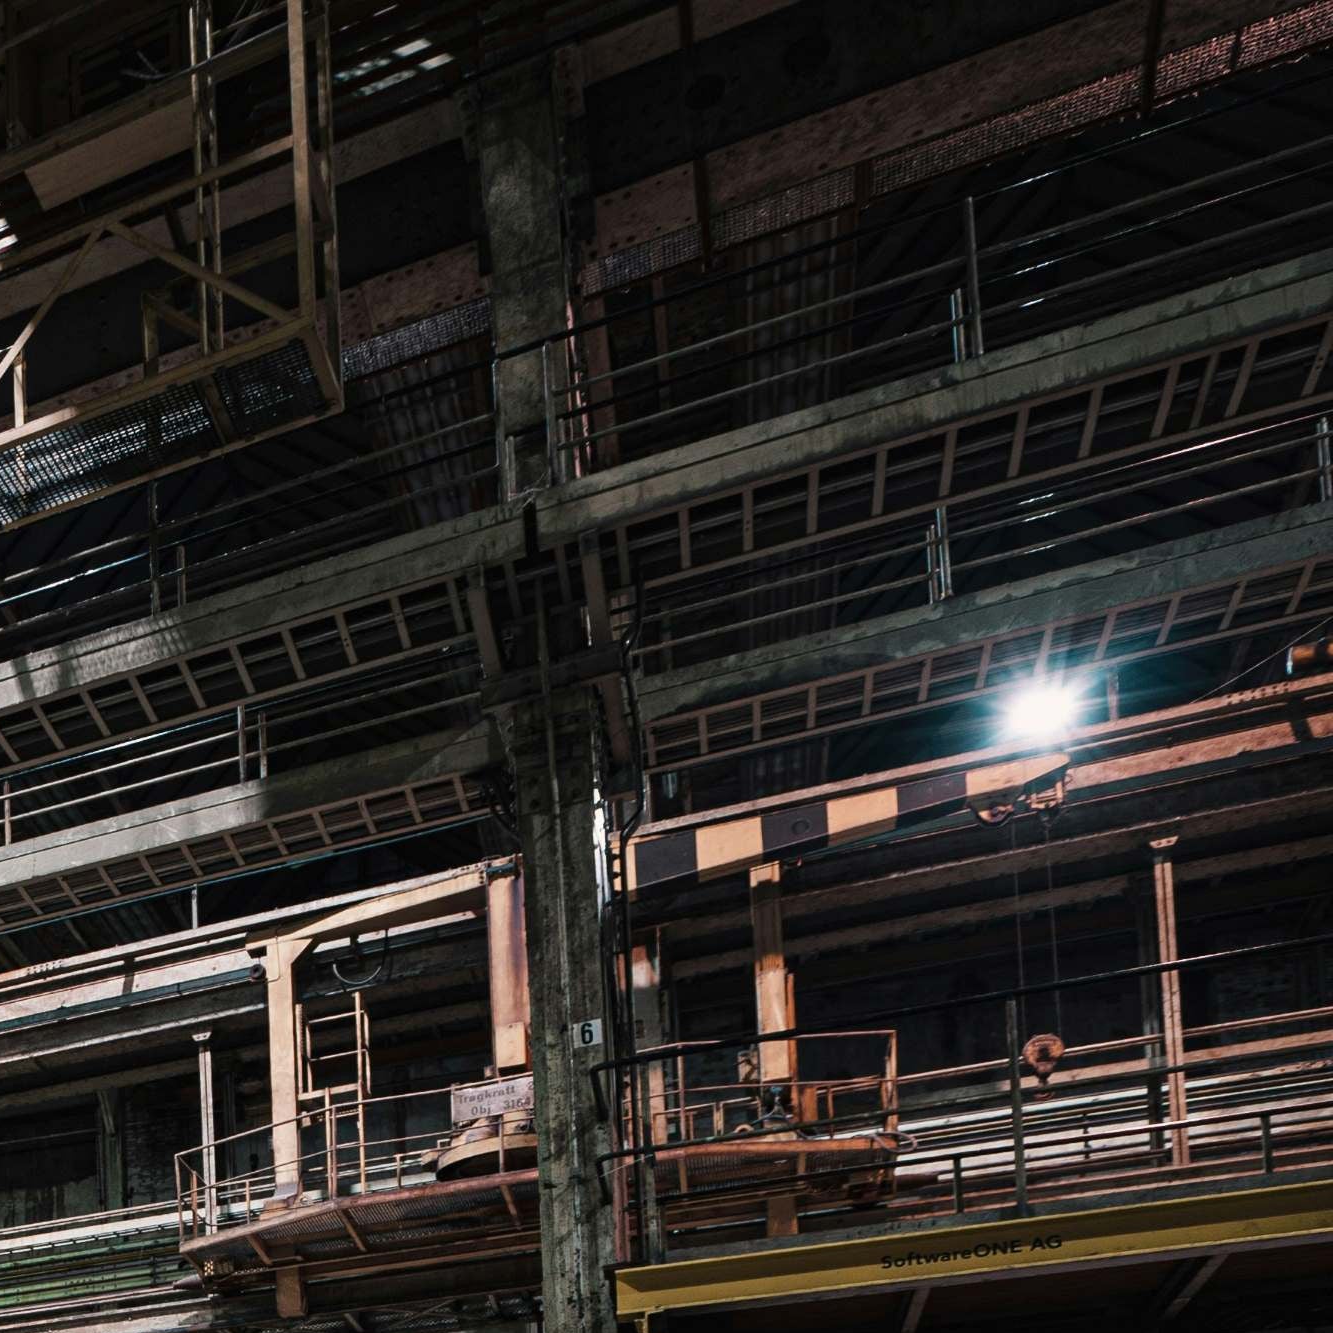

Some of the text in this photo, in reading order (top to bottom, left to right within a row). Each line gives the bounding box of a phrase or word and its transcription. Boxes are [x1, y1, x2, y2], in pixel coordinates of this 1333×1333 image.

[581, 1022, 593, 1045] 6
[459, 1085, 515, 1105] Tragkraft
[881, 1234, 1063, 1270] SoftwareONE AG
